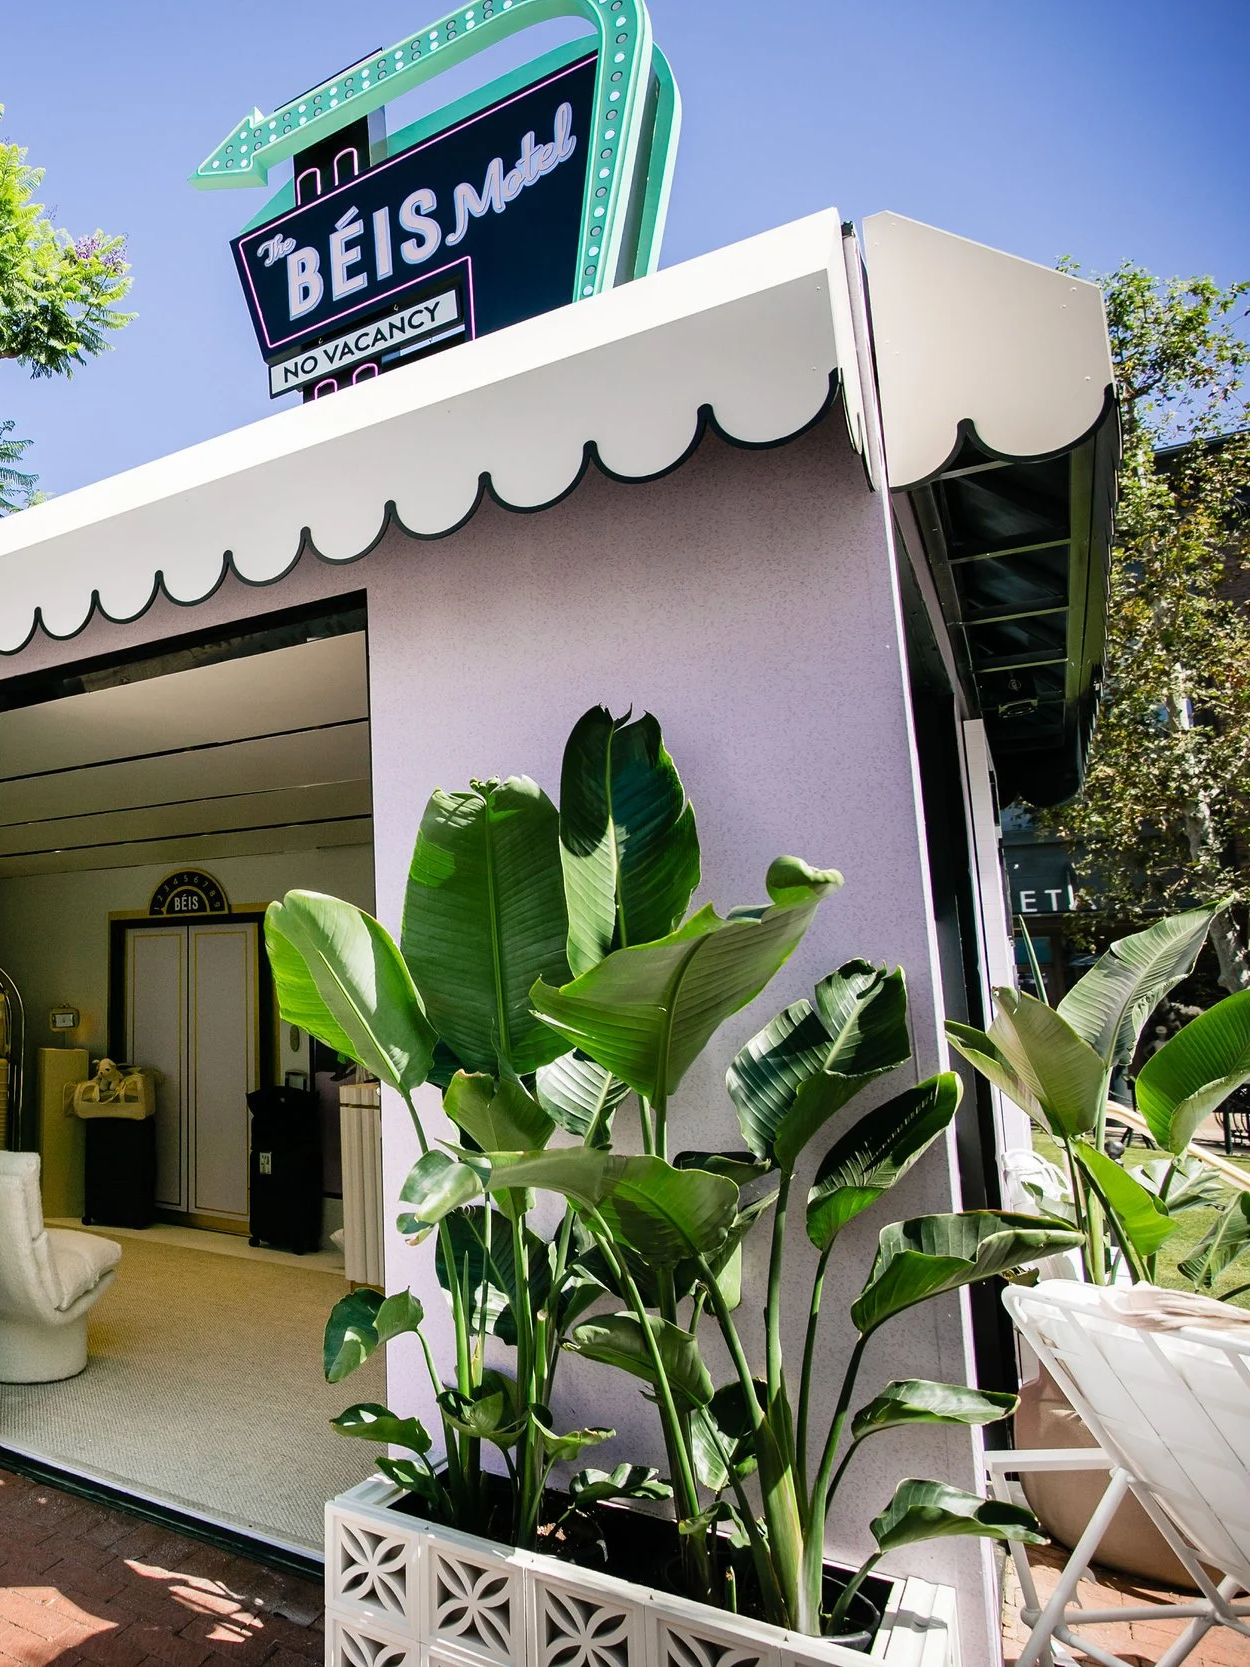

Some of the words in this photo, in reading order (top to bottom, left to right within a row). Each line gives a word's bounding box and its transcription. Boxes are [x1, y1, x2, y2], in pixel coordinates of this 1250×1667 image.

[257, 233, 296, 267] The
[287, 206, 440, 321] BÉIS
[444, 101, 576, 246] Motel
[284, 355, 318, 383] NO
[323, 301, 440, 364] VACANCY
[174, 893, 199, 911] BÉIS
